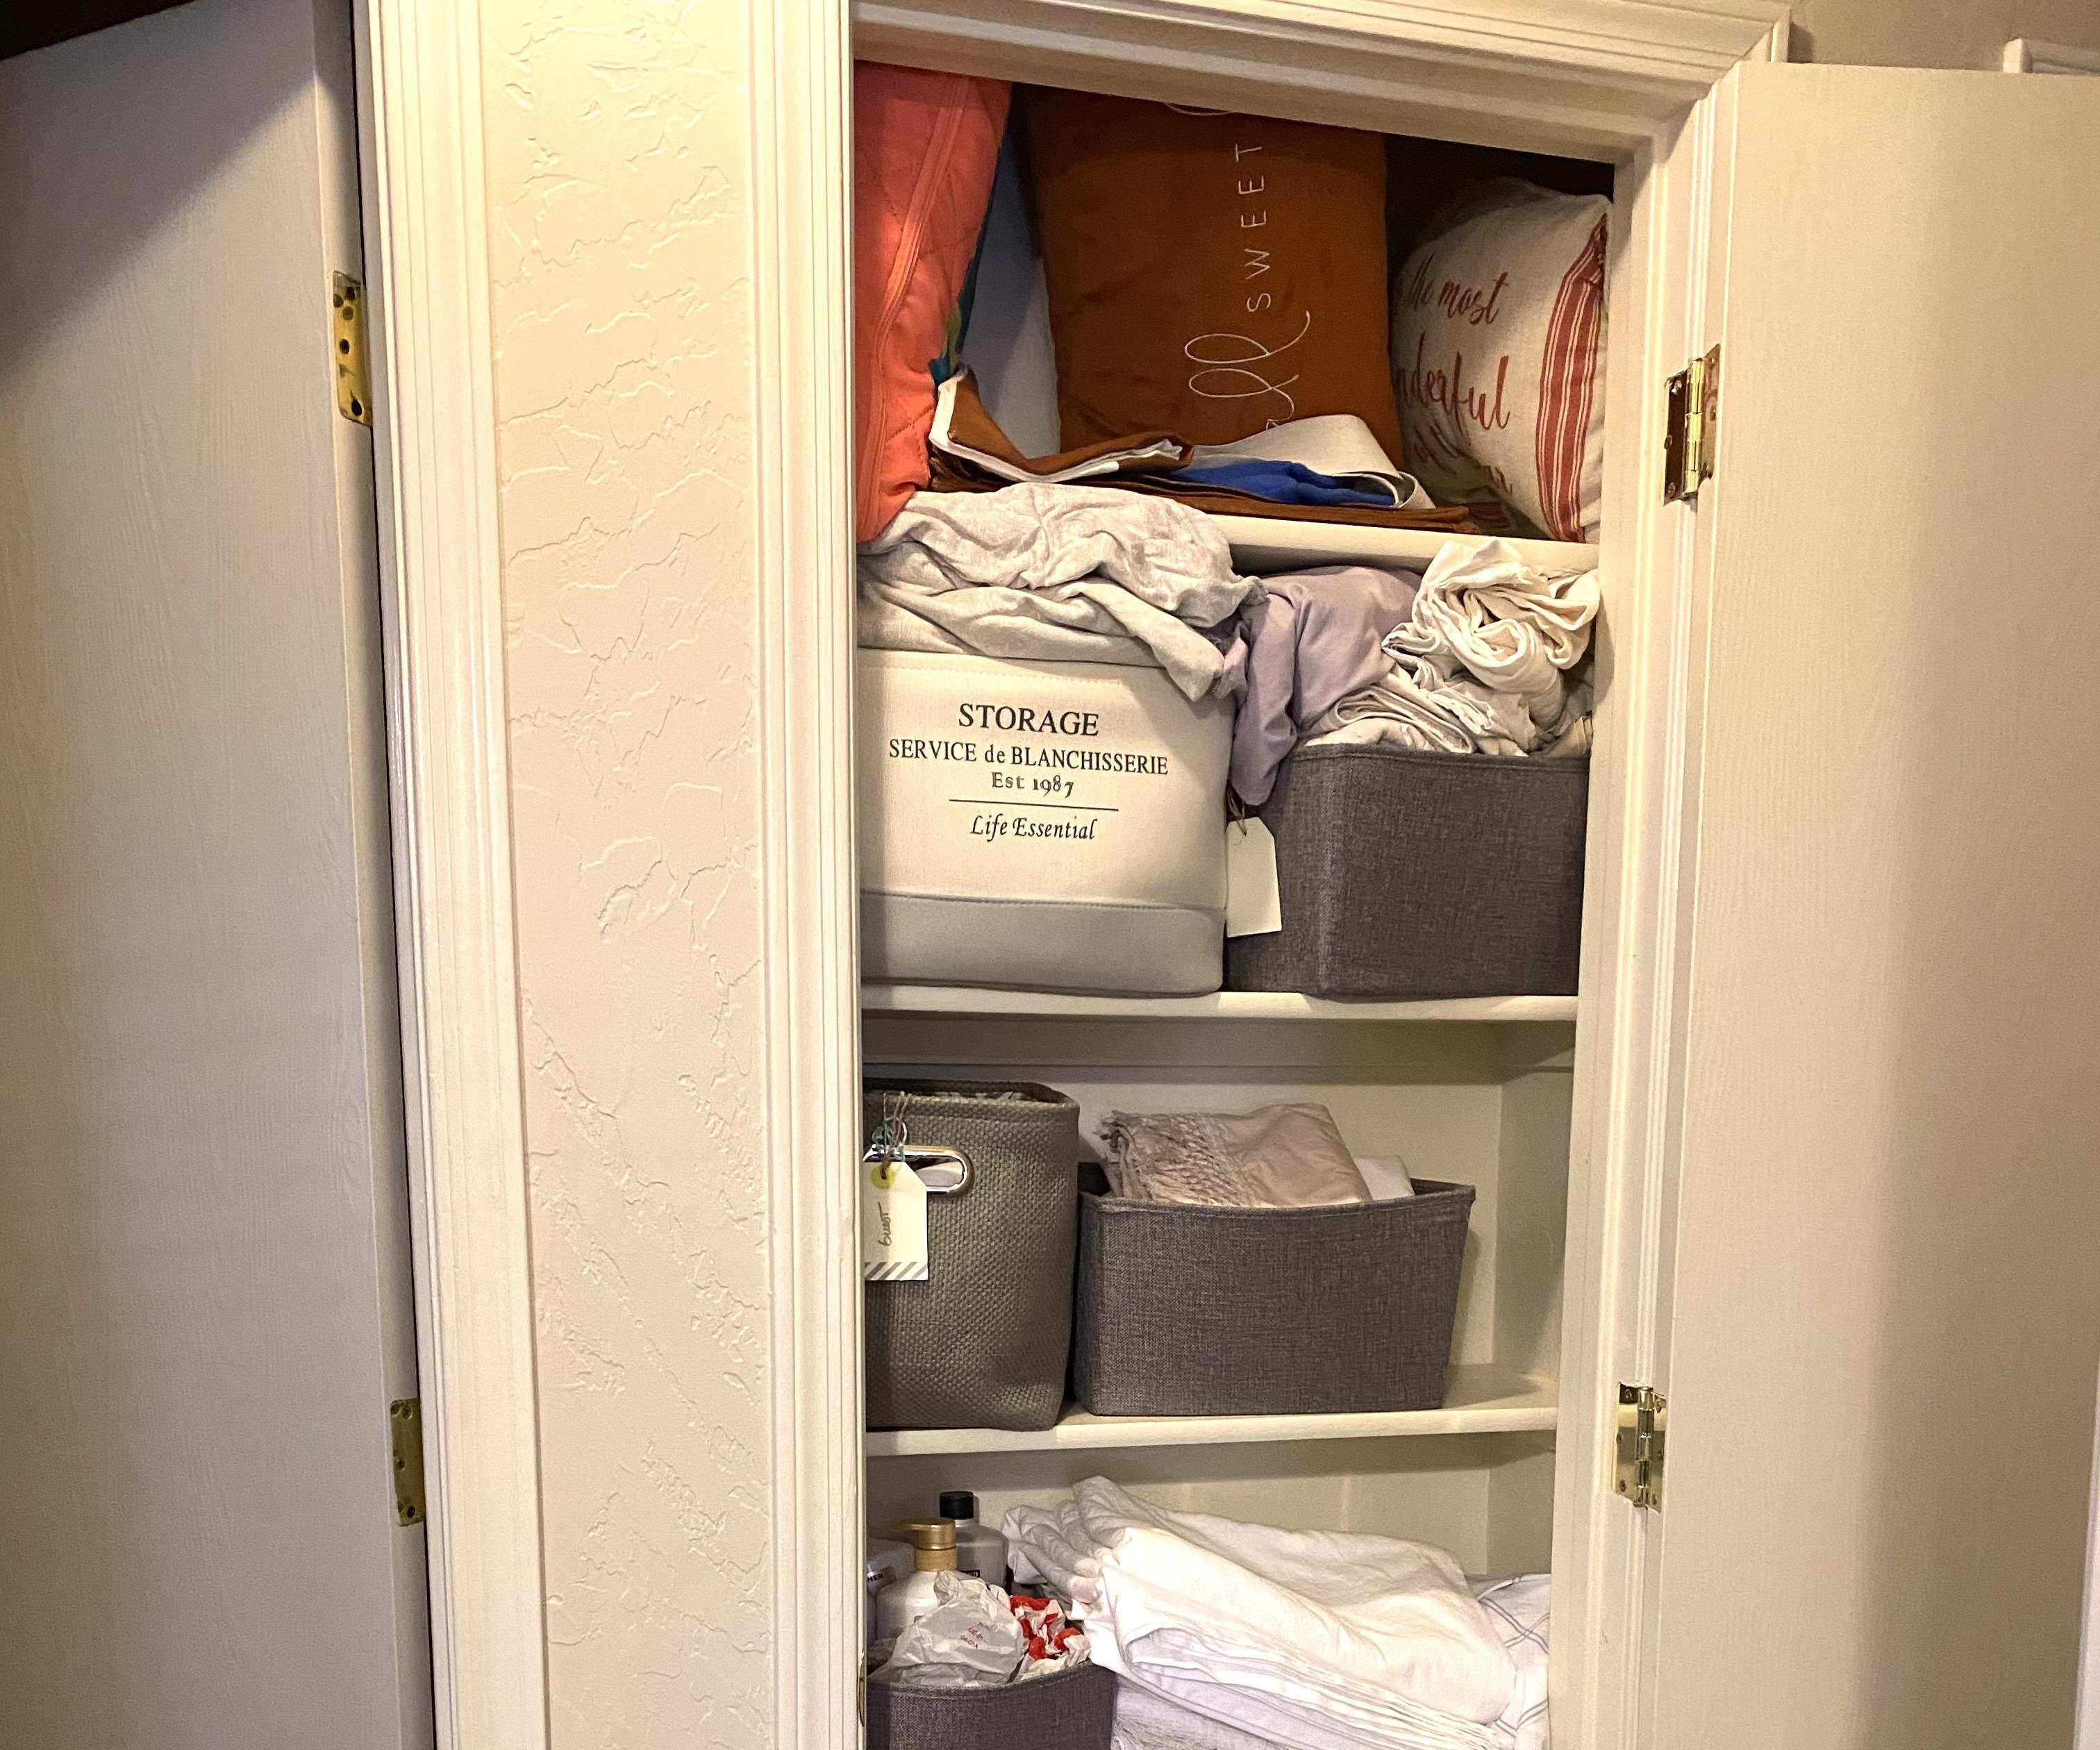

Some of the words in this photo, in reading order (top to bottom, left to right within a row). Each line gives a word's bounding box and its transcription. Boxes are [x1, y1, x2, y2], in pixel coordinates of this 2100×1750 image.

[1235, 142, 1272, 312] SWEET
[1438, 272, 1510, 325] most
[1394, 331, 1511, 433] nderful
[958, 703, 1099, 737] STORAGE
[889, 738, 977, 762] SERVICE
[984, 743, 1006, 764] de
[1010, 746, 1169, 776] BLANCHISSERIE
[991, 772, 1025, 790] Est
[1033, 774, 1074, 799] 1987
[969, 812, 1008, 843] Life
[1012, 815, 1098, 840] Essential
